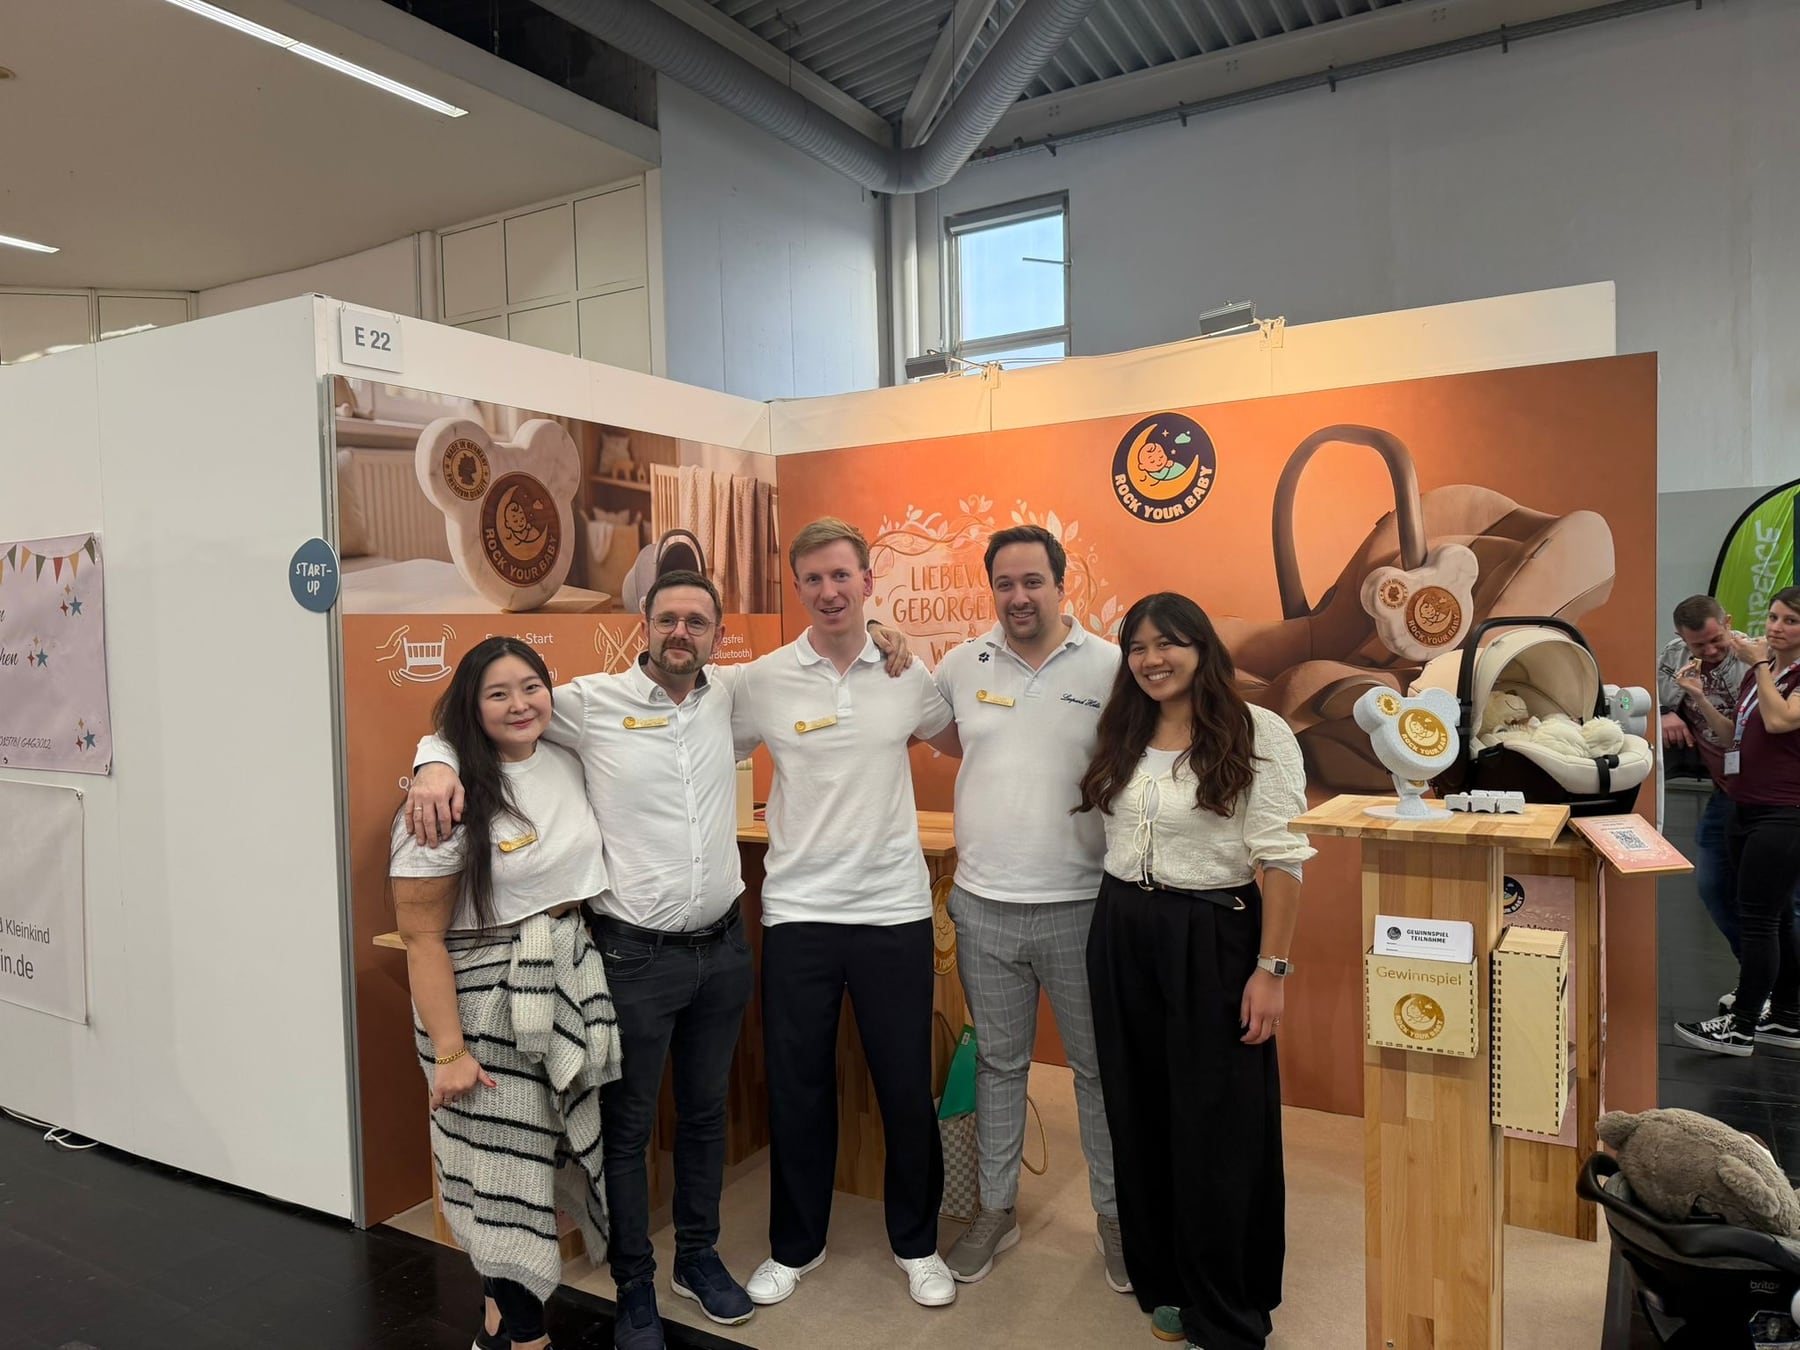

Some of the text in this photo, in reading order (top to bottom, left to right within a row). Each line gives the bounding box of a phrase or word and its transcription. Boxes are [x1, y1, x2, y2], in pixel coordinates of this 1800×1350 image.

[355, 326, 391, 352] E 22
[1115, 466, 1213, 520] ROCK YOUR BABY
[486, 527, 558, 580] ROCK YOUR BABY
[296, 562, 332, 577] START-
[307, 580, 320, 596] UP
[1408, 614, 1460, 644] ROCK YOUR BABY
[1402, 734, 1418, 751] ROCK
[6, 919, 50, 944] Kleinkind
[1406, 929, 1448, 937] GEWINNSPIEL
[1376, 966, 1461, 986] Gewinnspiel
